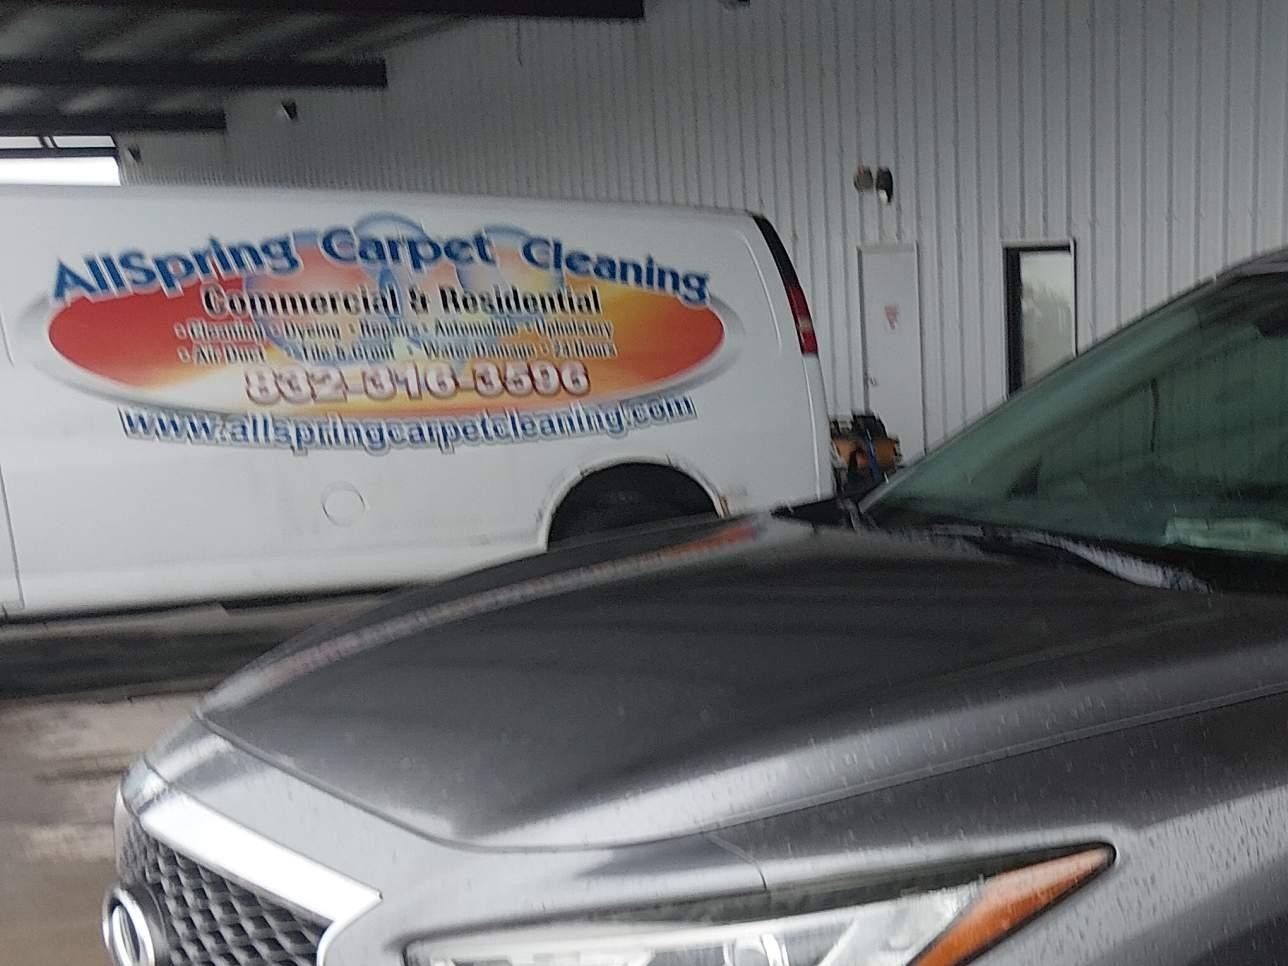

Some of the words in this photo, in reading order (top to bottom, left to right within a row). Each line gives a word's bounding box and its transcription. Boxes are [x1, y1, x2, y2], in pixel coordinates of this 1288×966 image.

[54, 235, 301, 301] AllSpring
[322, 228, 496, 272] Carpet
[521, 236, 711, 305] Cleaning
[203, 283, 399, 317] Commercial
[438, 284, 602, 316] Residential
[245, 361, 592, 404] 832-316-3596
[118, 396, 697, 452] www.allspringcarpetcleaning.com
